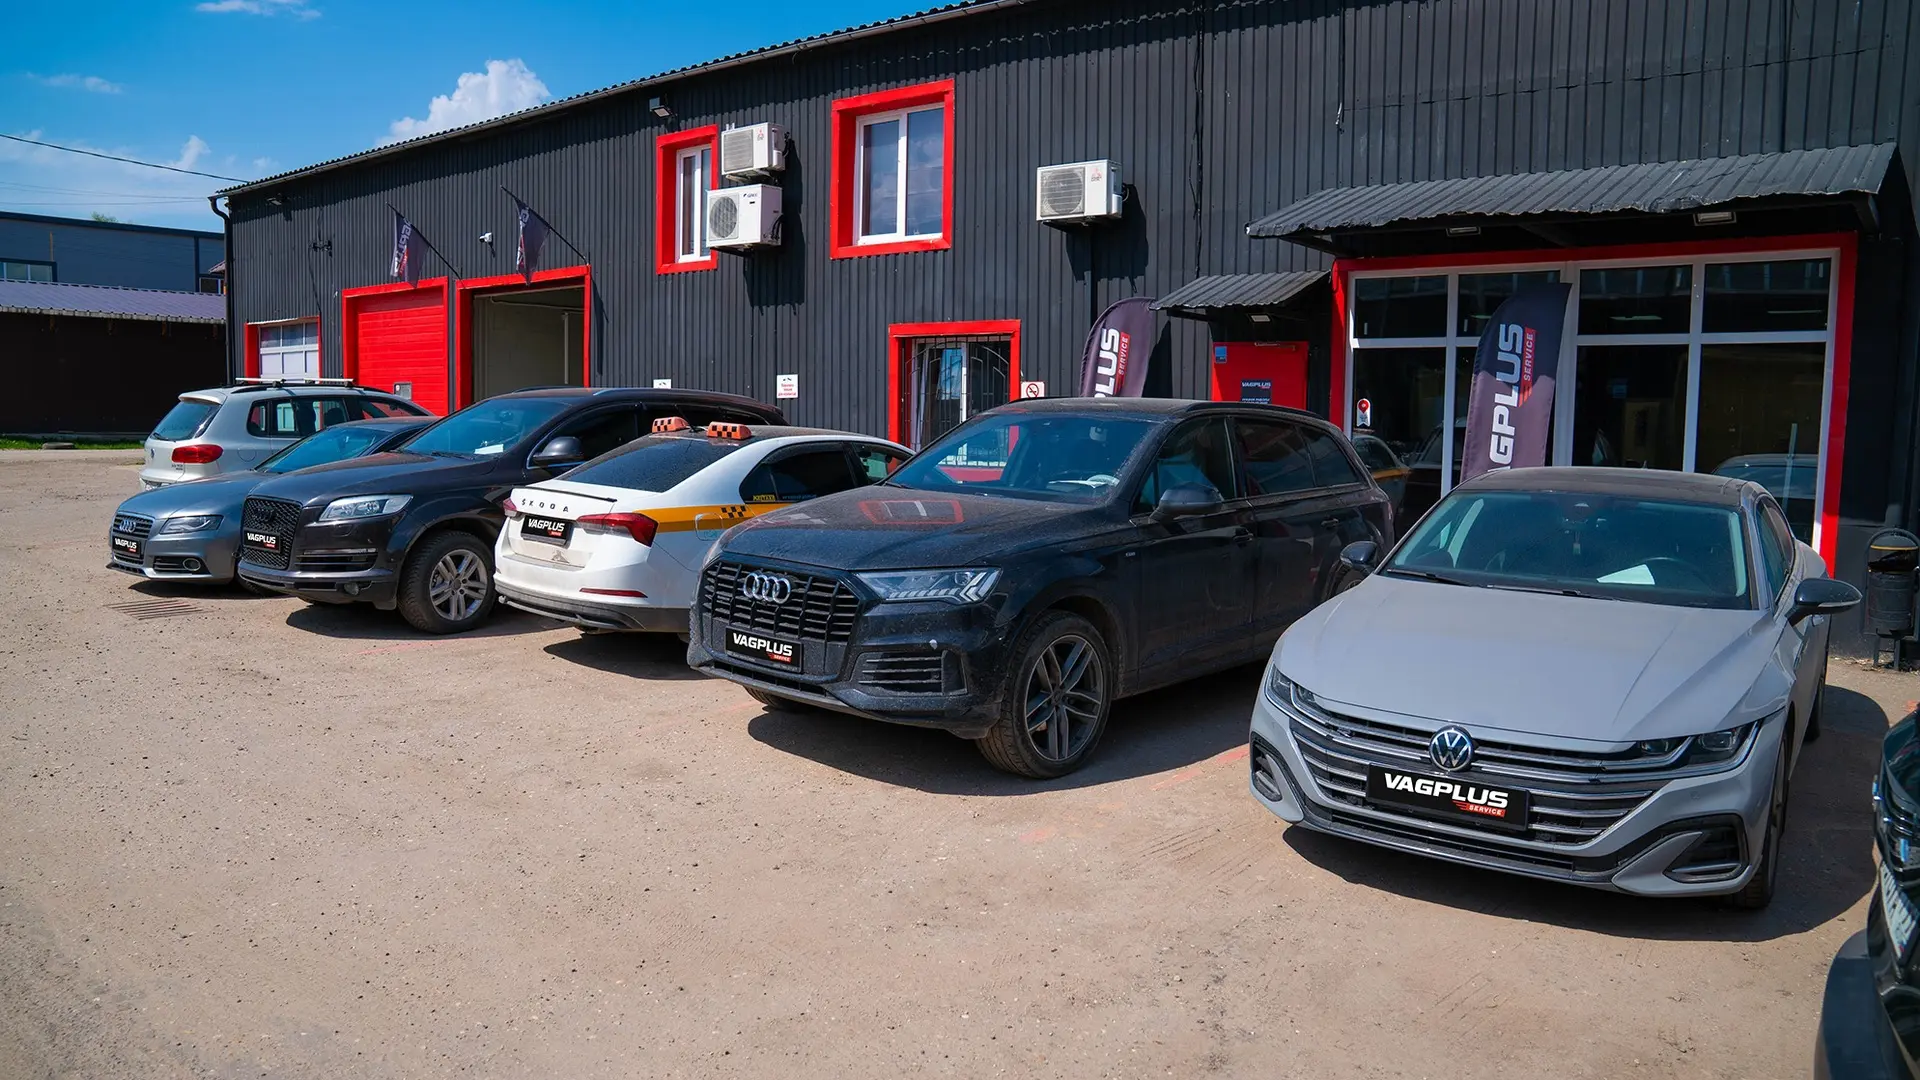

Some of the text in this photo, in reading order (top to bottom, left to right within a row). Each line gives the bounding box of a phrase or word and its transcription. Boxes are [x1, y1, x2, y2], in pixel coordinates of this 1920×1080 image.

[1094, 328, 1120, 397] LUS
[1118, 336, 1129, 376] SERVICE
[1524, 332, 1534, 381] SERVICE
[1487, 323, 1523, 472] GPLUS
[247, 532, 276, 544] VAGPLUS
[528, 518, 565, 532] VAGPLUS
[115, 537, 137, 549] VAGPLUS
[733, 632, 793, 657] VAGPLUS
[1384, 772, 1509, 809] VAGPLUS
[1468, 804, 1503, 816] SERVICE
